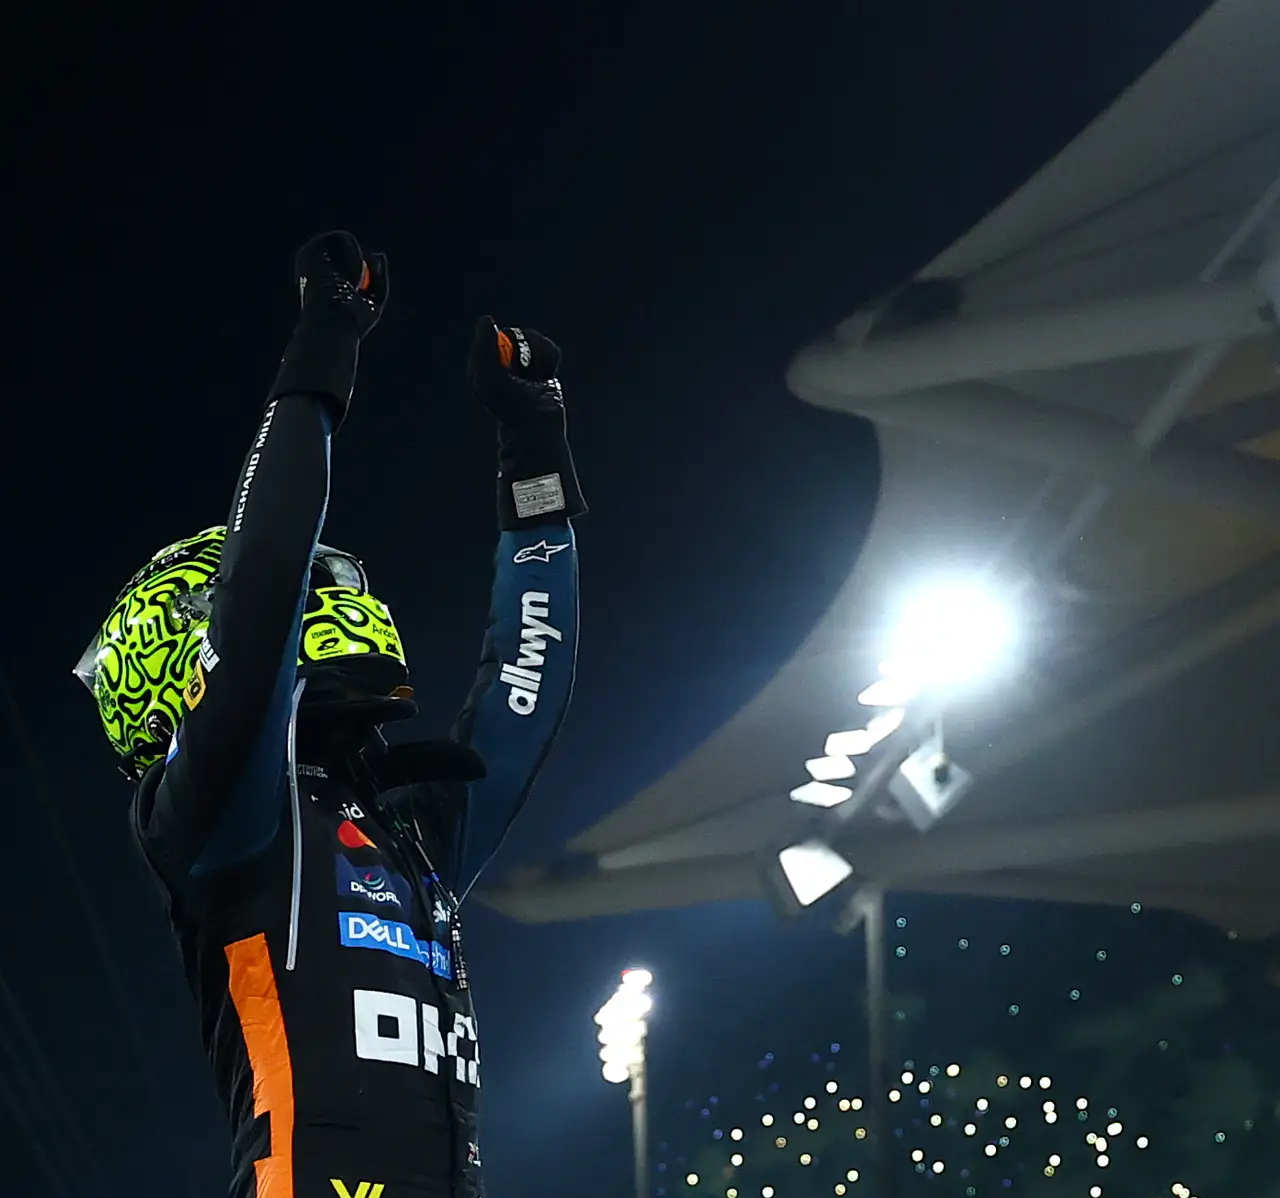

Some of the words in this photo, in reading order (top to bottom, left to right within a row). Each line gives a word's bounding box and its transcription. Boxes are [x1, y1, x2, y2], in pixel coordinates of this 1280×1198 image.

[232, 452, 261, 533] RICHARD
[256, 400, 279, 449] MILL
[500, 591, 562, 715] allwyn
[348, 916, 411, 950] DELL
